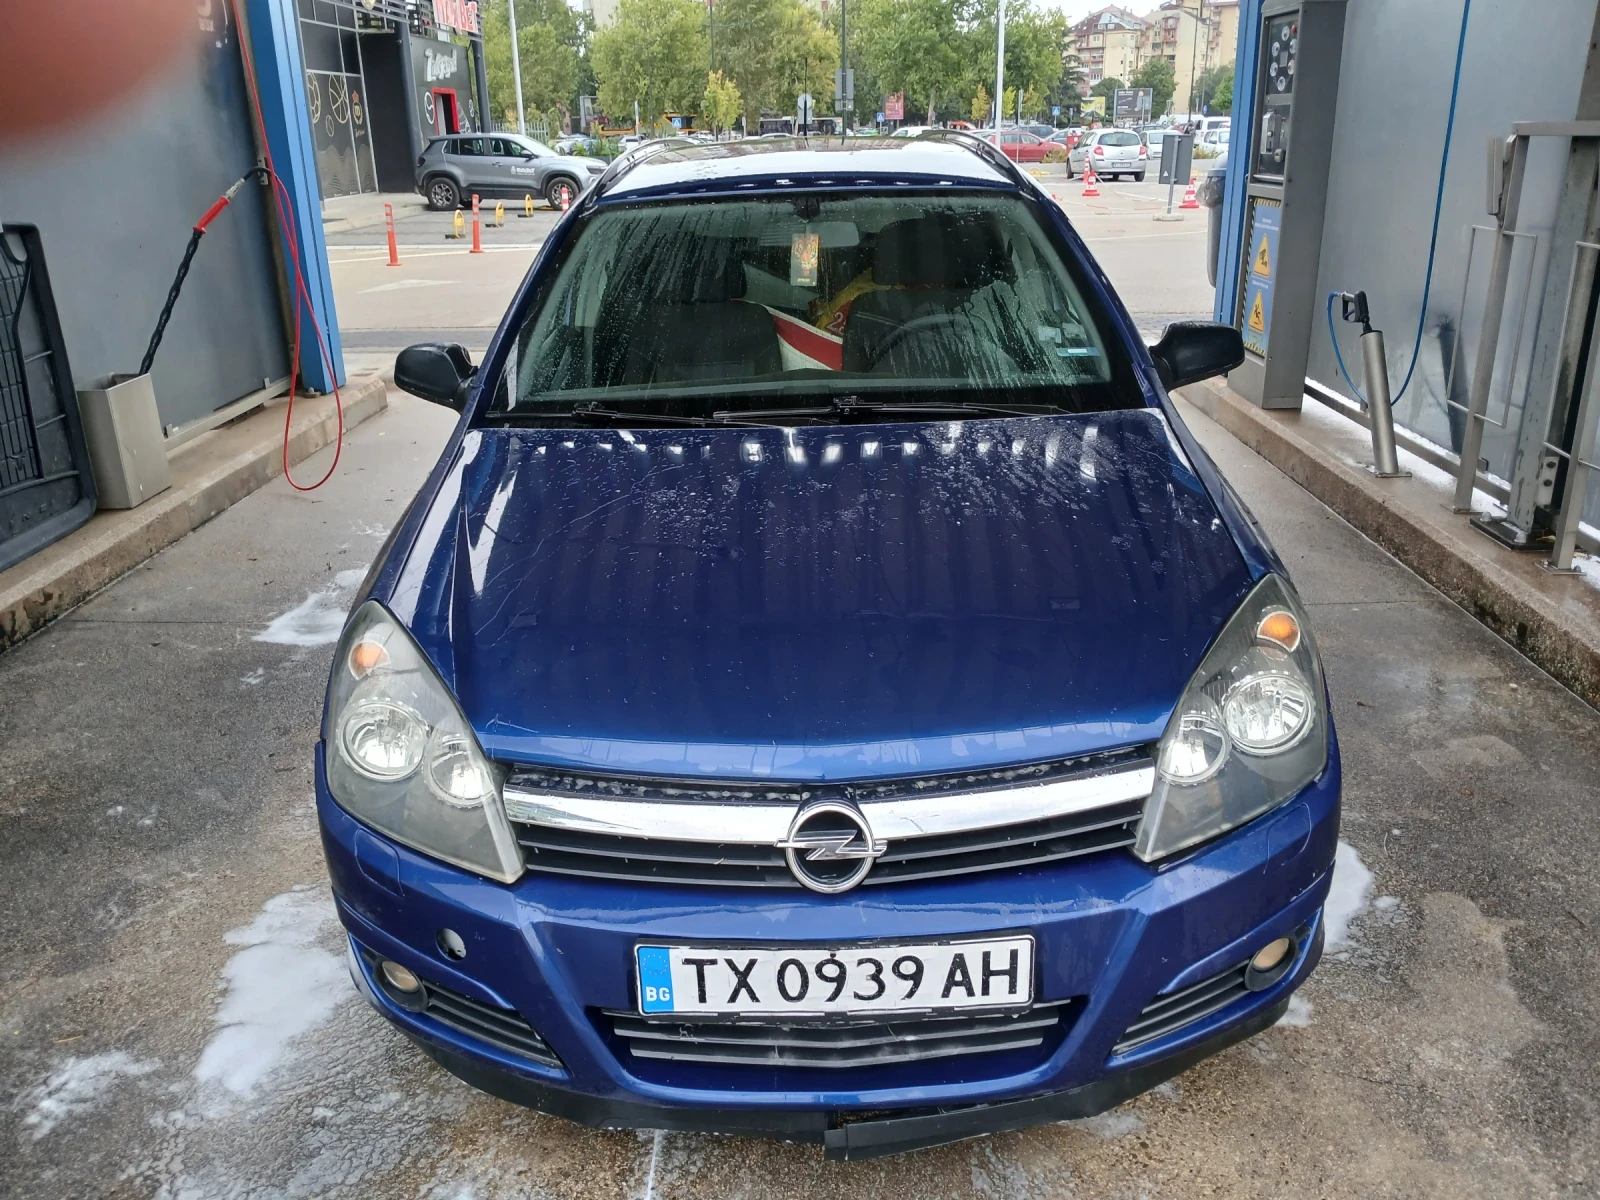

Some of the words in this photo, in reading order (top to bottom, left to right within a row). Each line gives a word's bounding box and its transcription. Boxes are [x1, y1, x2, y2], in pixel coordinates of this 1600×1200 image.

[645, 986, 671, 1002] BG
[682, 957, 761, 1004] TX
[776, 954, 925, 1003] 0939
[940, 948, 1019, 1000] AH
